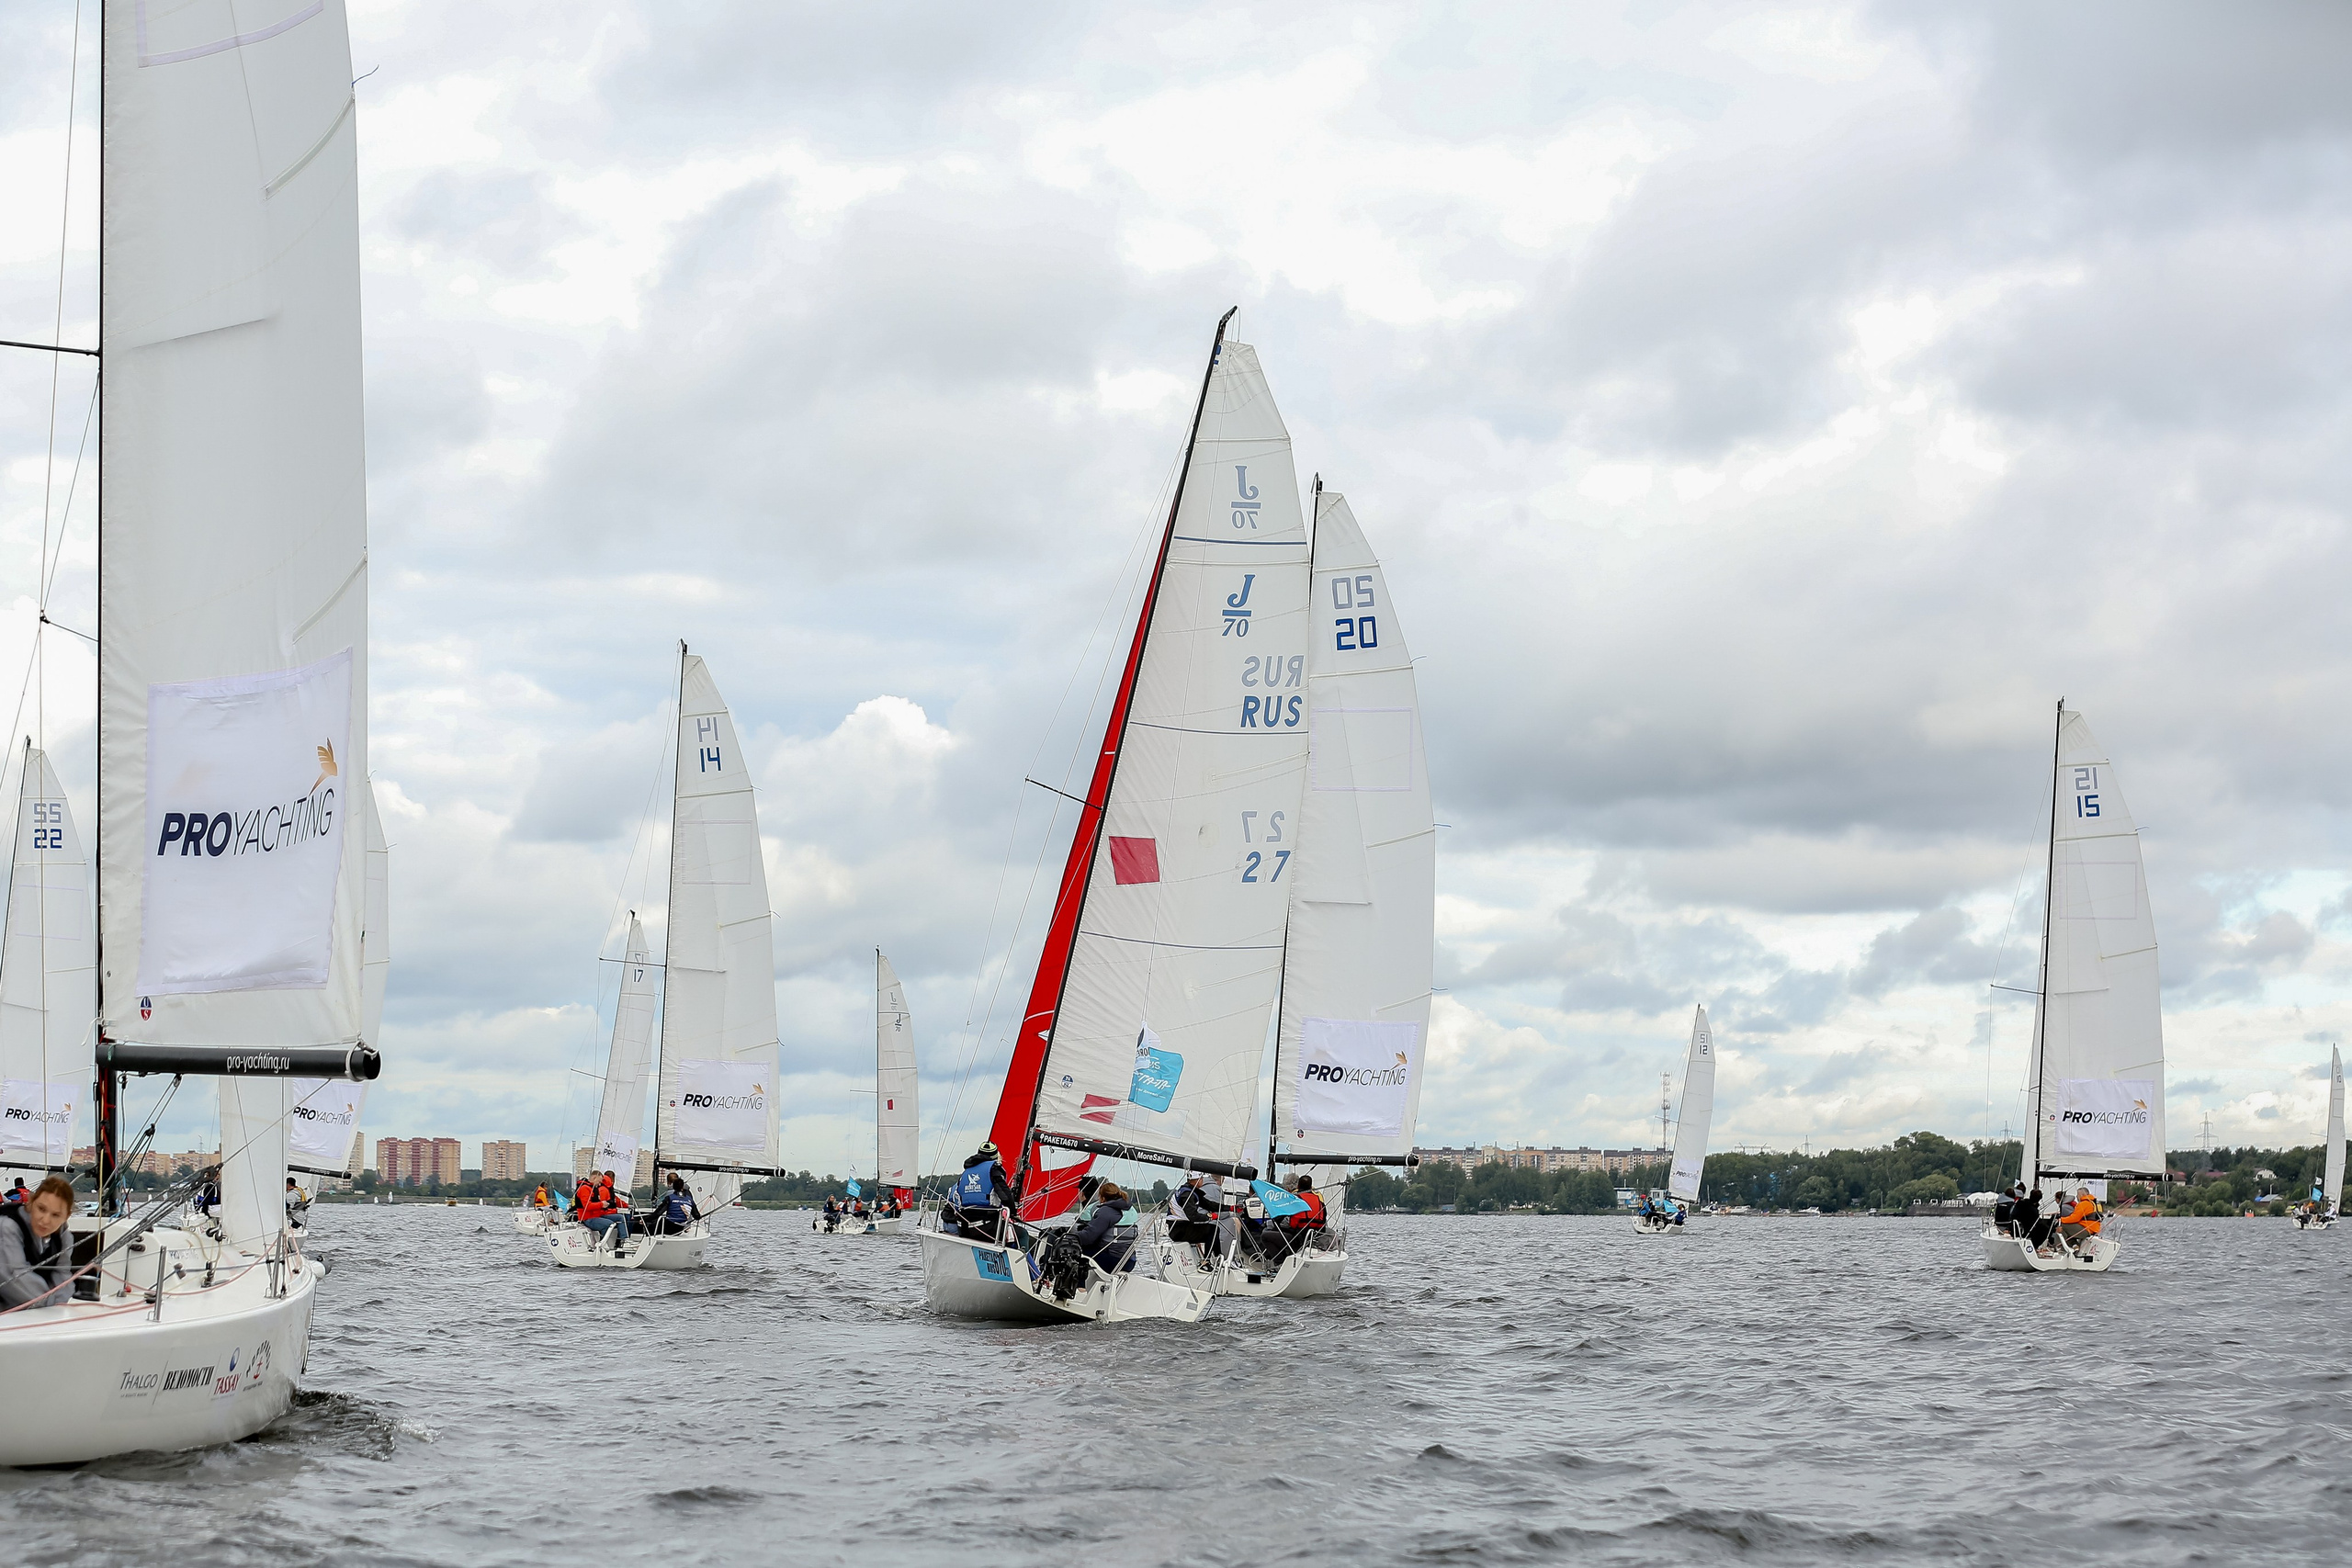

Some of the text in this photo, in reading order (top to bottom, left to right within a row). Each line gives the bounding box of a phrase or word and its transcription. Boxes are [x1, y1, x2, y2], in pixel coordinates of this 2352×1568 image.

[1227, 574, 1256, 608] J
[1221, 617, 1250, 637] 70
[1335, 615, 1378, 651] 20
[1239, 694, 1303, 728] RUS
[699, 746, 721, 773] 14
[2076, 794, 2100, 818] 15
[156, 787, 335, 857] PROYACHTING
[33, 828, 62, 850] 22
[1241, 849, 1291, 883] 27
[633, 968, 644, 983] 17
[1698, 1044, 1708, 1055] 12
[226, 1052, 290, 1074] pro-yachting.ru
[1304, 1064, 1407, 1086] PROYACHTING
[683, 1093, 763, 1111] PROYACHTING
[5, 1108, 70, 1124] PROYACHTING
[292, 1106, 352, 1125] PROYACHTING
[2062, 1110, 2147, 1124] PROYACHTING
[1136, 1151, 1173, 1164] MoreSail.ru
[1348, 1156, 1383, 1164] pro-yachting.ru
[120, 1368, 159, 1390] THALGO
[213, 1372, 242, 1395] TASSAY
